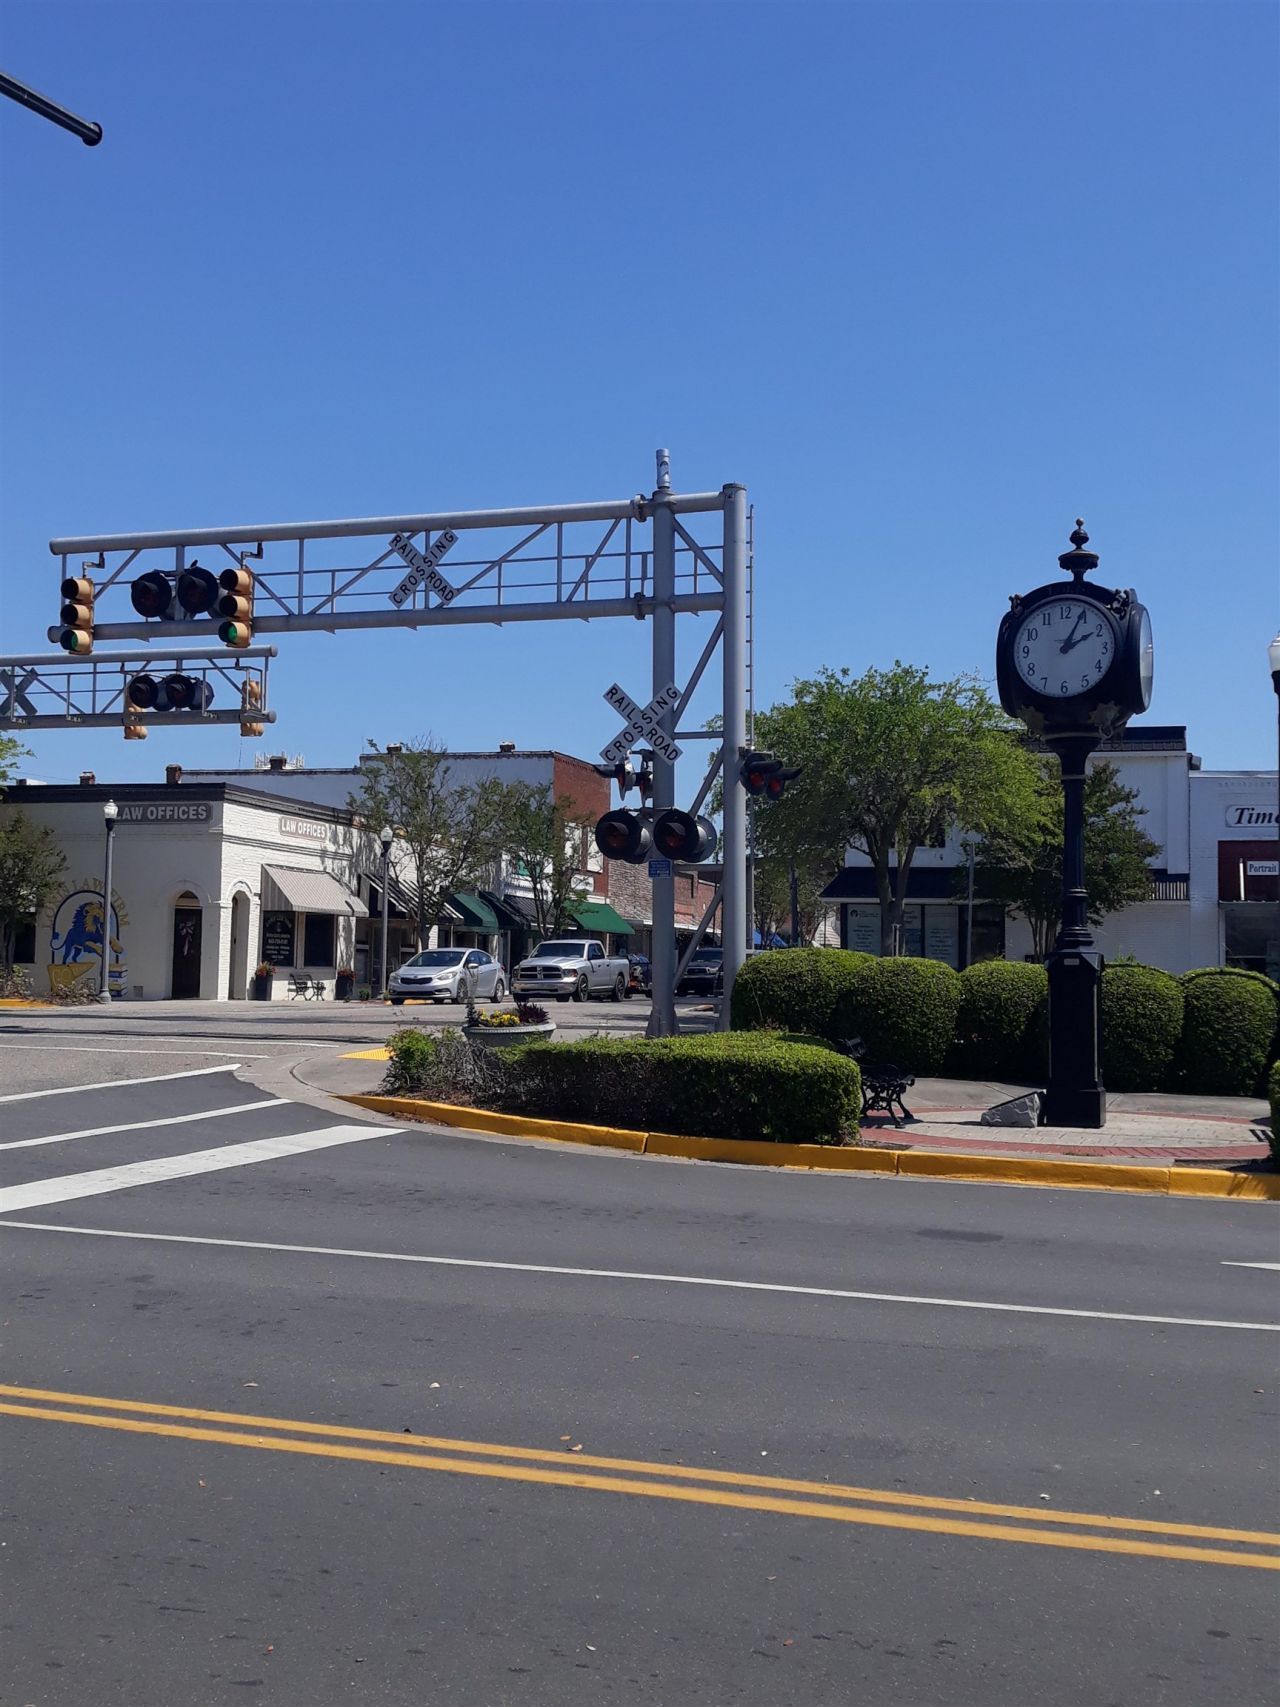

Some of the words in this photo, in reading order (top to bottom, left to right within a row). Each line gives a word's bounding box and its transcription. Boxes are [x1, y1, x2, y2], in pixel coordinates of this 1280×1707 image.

[393, 532, 454, 604] CROSSING
[1060, 606, 1072, 619] 12
[1042, 613, 1051, 626] 11
[1026, 628, 1038, 642] 10
[1096, 624, 1104, 637] 2
[1022, 646, 1030, 658] 9
[1102, 642, 1108, 655] 3
[1028, 663, 1035, 676] 8
[1095, 659, 1102, 673] 4
[1040, 677, 1048, 690] 7
[1061, 681, 1068, 694] 6
[1081, 675, 1089, 688] 5
[605, 687, 678, 761] CROSSING
[147, 806, 207, 820] OFFICES
[281, 818, 297, 833] LAW
[297, 822, 325, 838] OFFICES
[1249, 864, 1277, 873] Portrait
